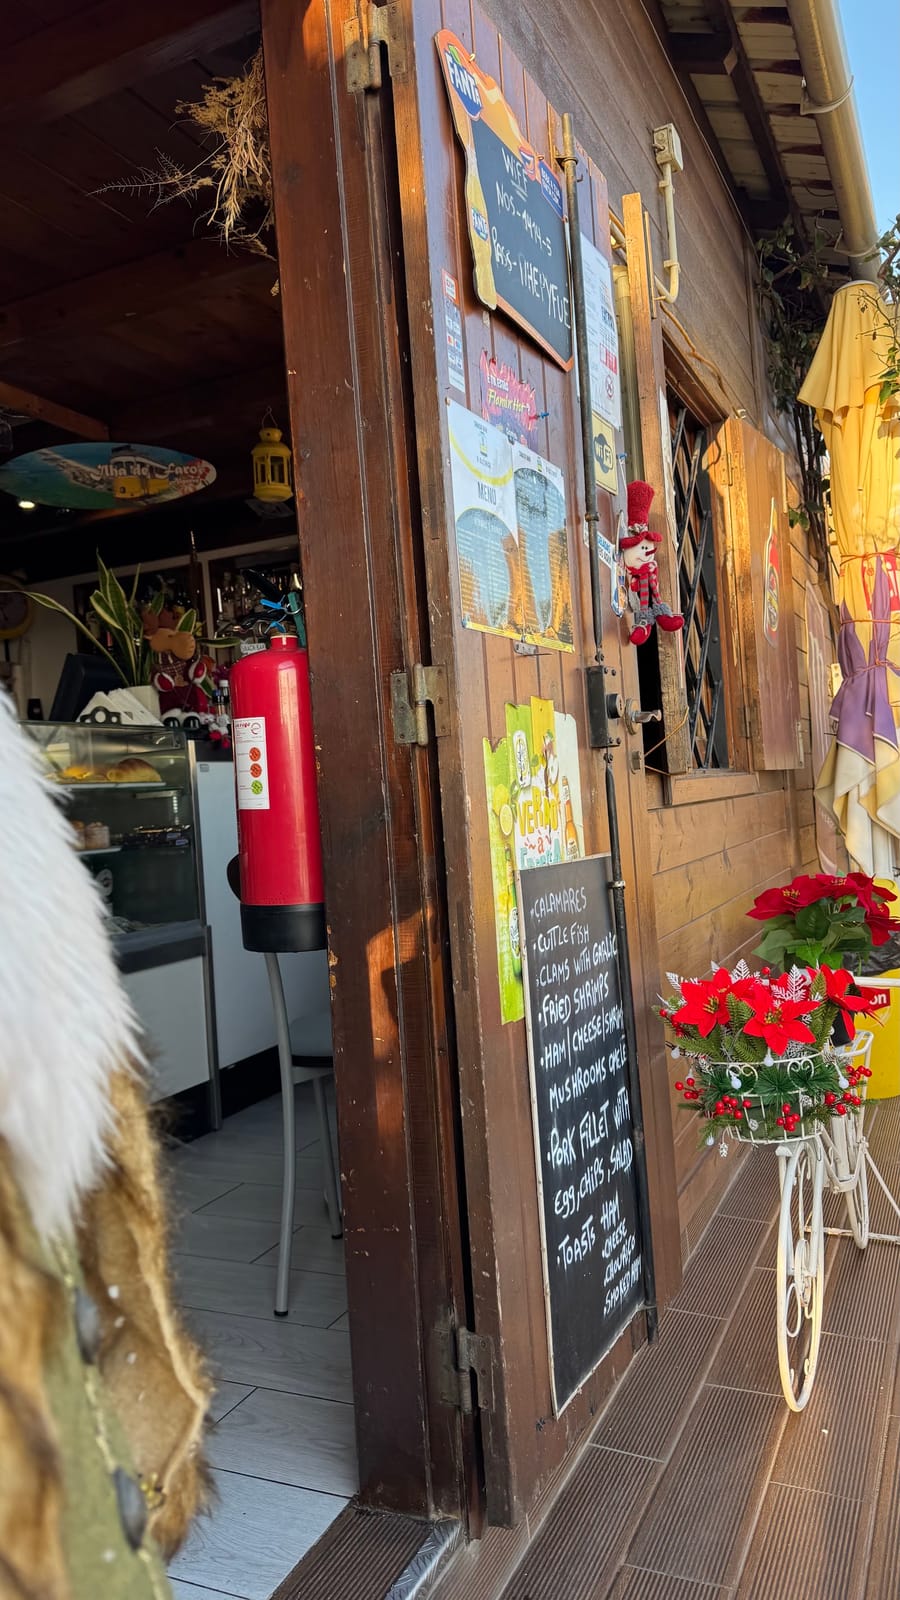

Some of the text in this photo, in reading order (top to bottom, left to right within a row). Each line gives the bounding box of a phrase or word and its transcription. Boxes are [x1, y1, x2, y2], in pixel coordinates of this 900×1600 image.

[446, 51, 482, 105] FANTA
[539, 957, 570, 987] CLAMS
[549, 1055, 607, 1113] MUSHROOMS
[549, 1125, 577, 1171] PORK
